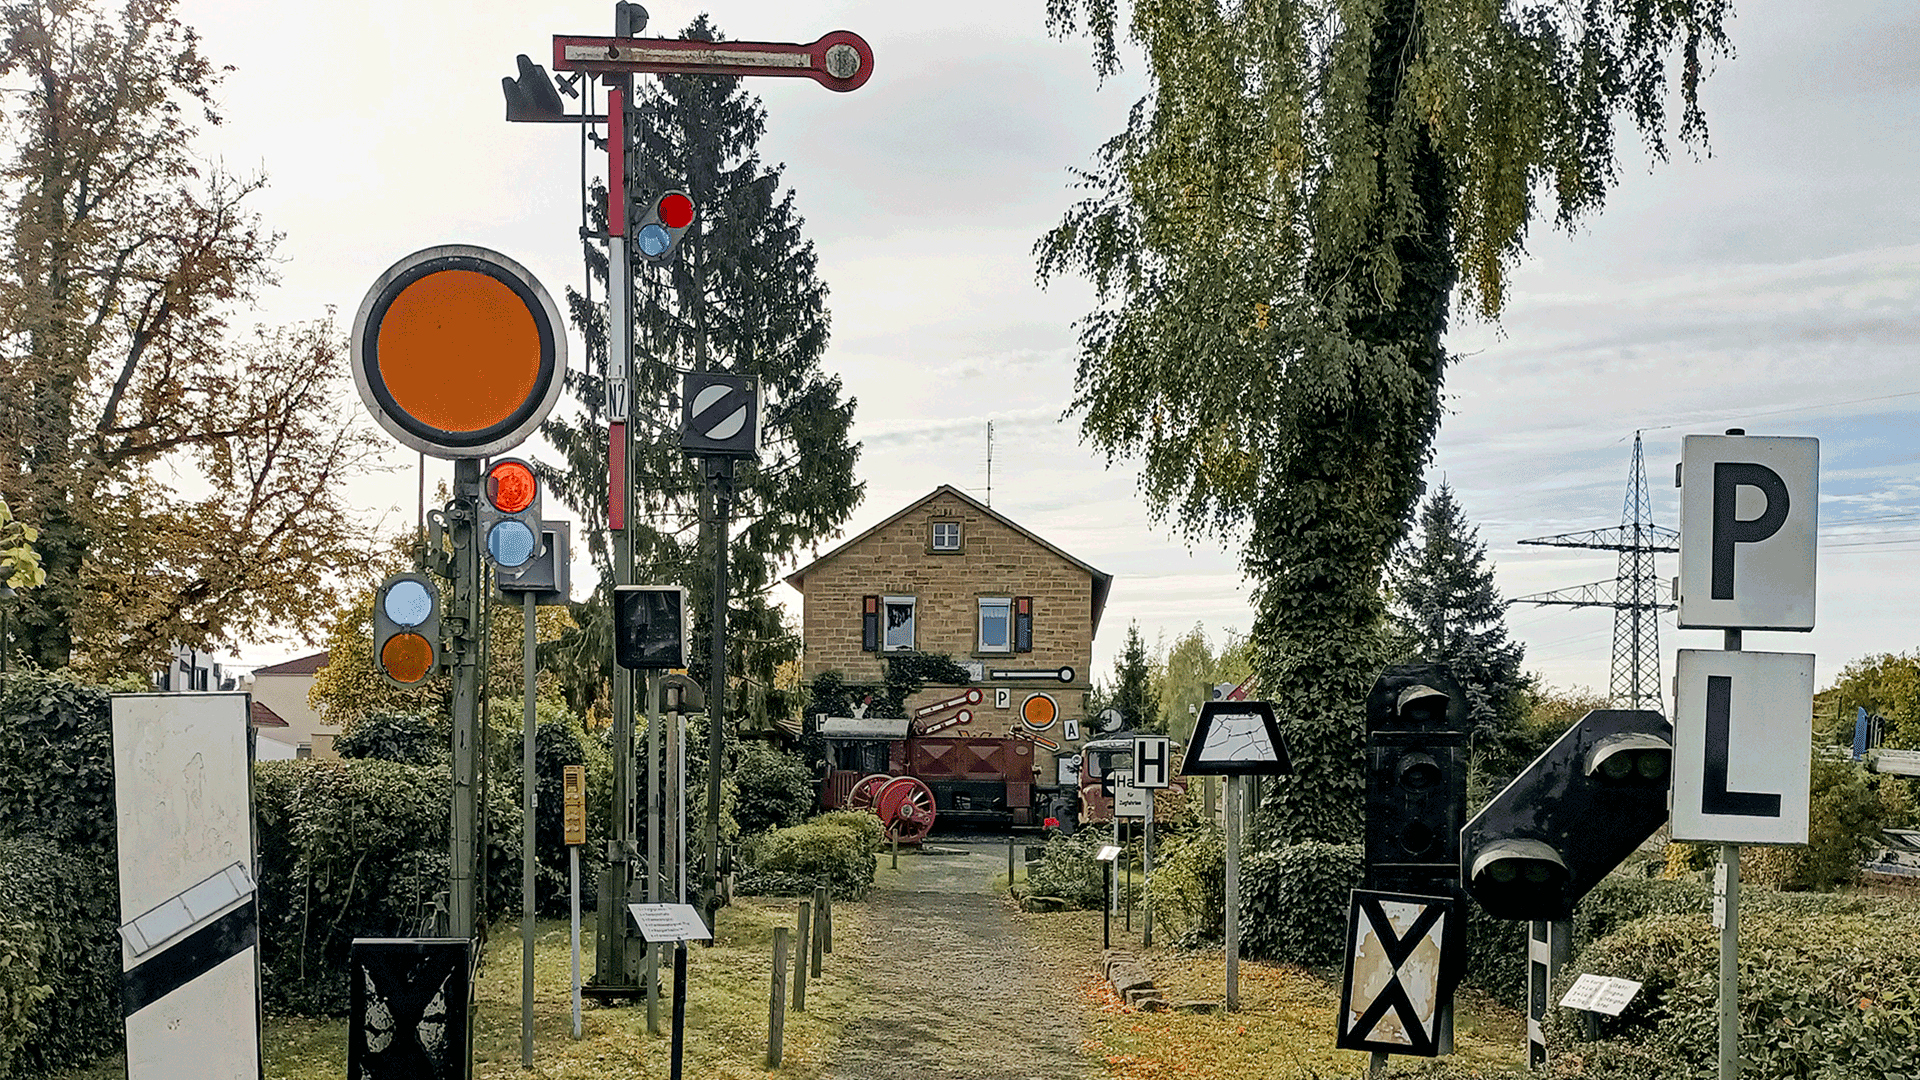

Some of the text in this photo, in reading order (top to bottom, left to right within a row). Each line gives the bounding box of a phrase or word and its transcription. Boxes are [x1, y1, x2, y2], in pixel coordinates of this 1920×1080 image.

[609, 383, 626, 418] N2
[1710, 462, 1791, 600] P
[998, 691, 1007, 706] P
[1068, 722, 1077, 737] A
[1701, 675, 1782, 817] L
[1138, 741, 1166, 783] H
[1117, 775, 1134, 788] Ha
